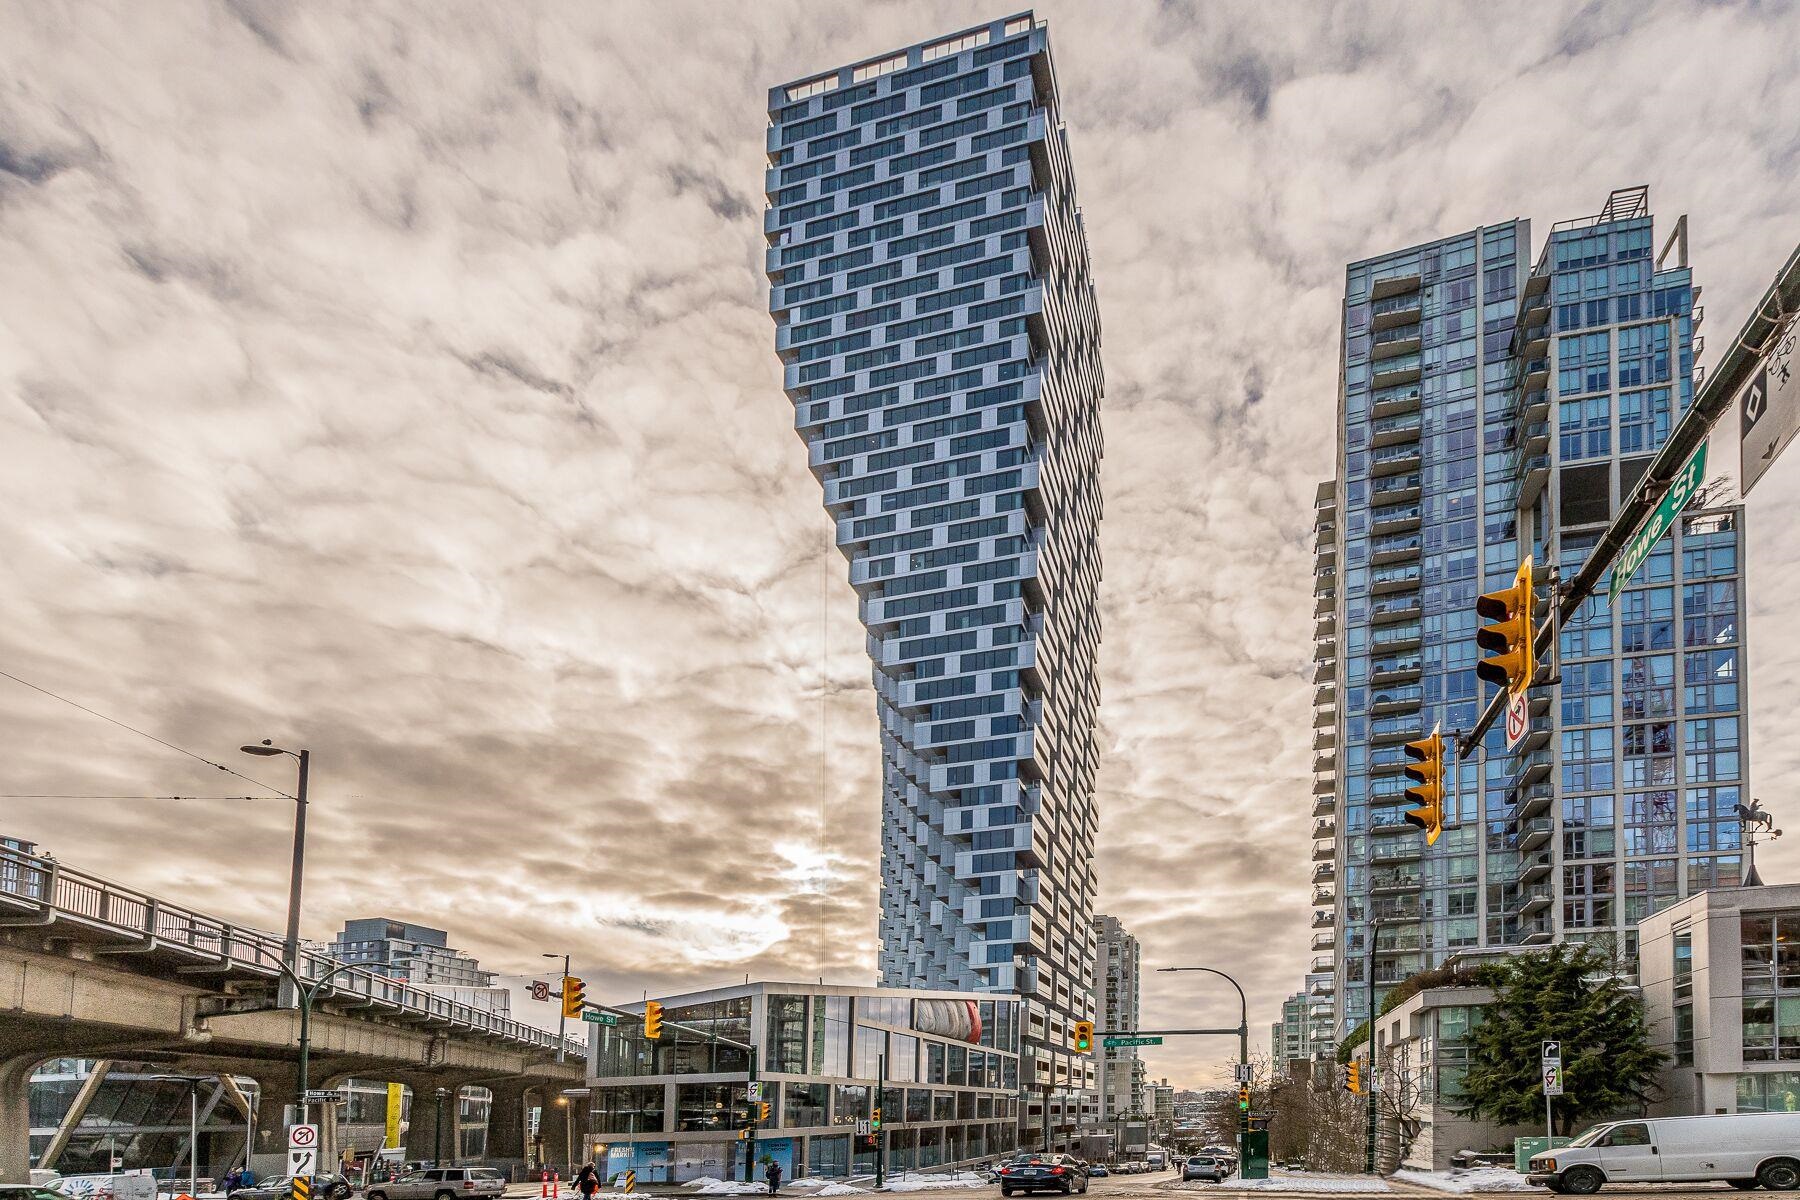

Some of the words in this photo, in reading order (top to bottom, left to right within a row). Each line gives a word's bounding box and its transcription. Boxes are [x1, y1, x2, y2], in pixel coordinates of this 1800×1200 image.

[1615, 514, 1663, 589] Howe
[1671, 462, 1697, 511] St
[585, 1012, 604, 1022] Howe
[606, 1015, 614, 1023] St
